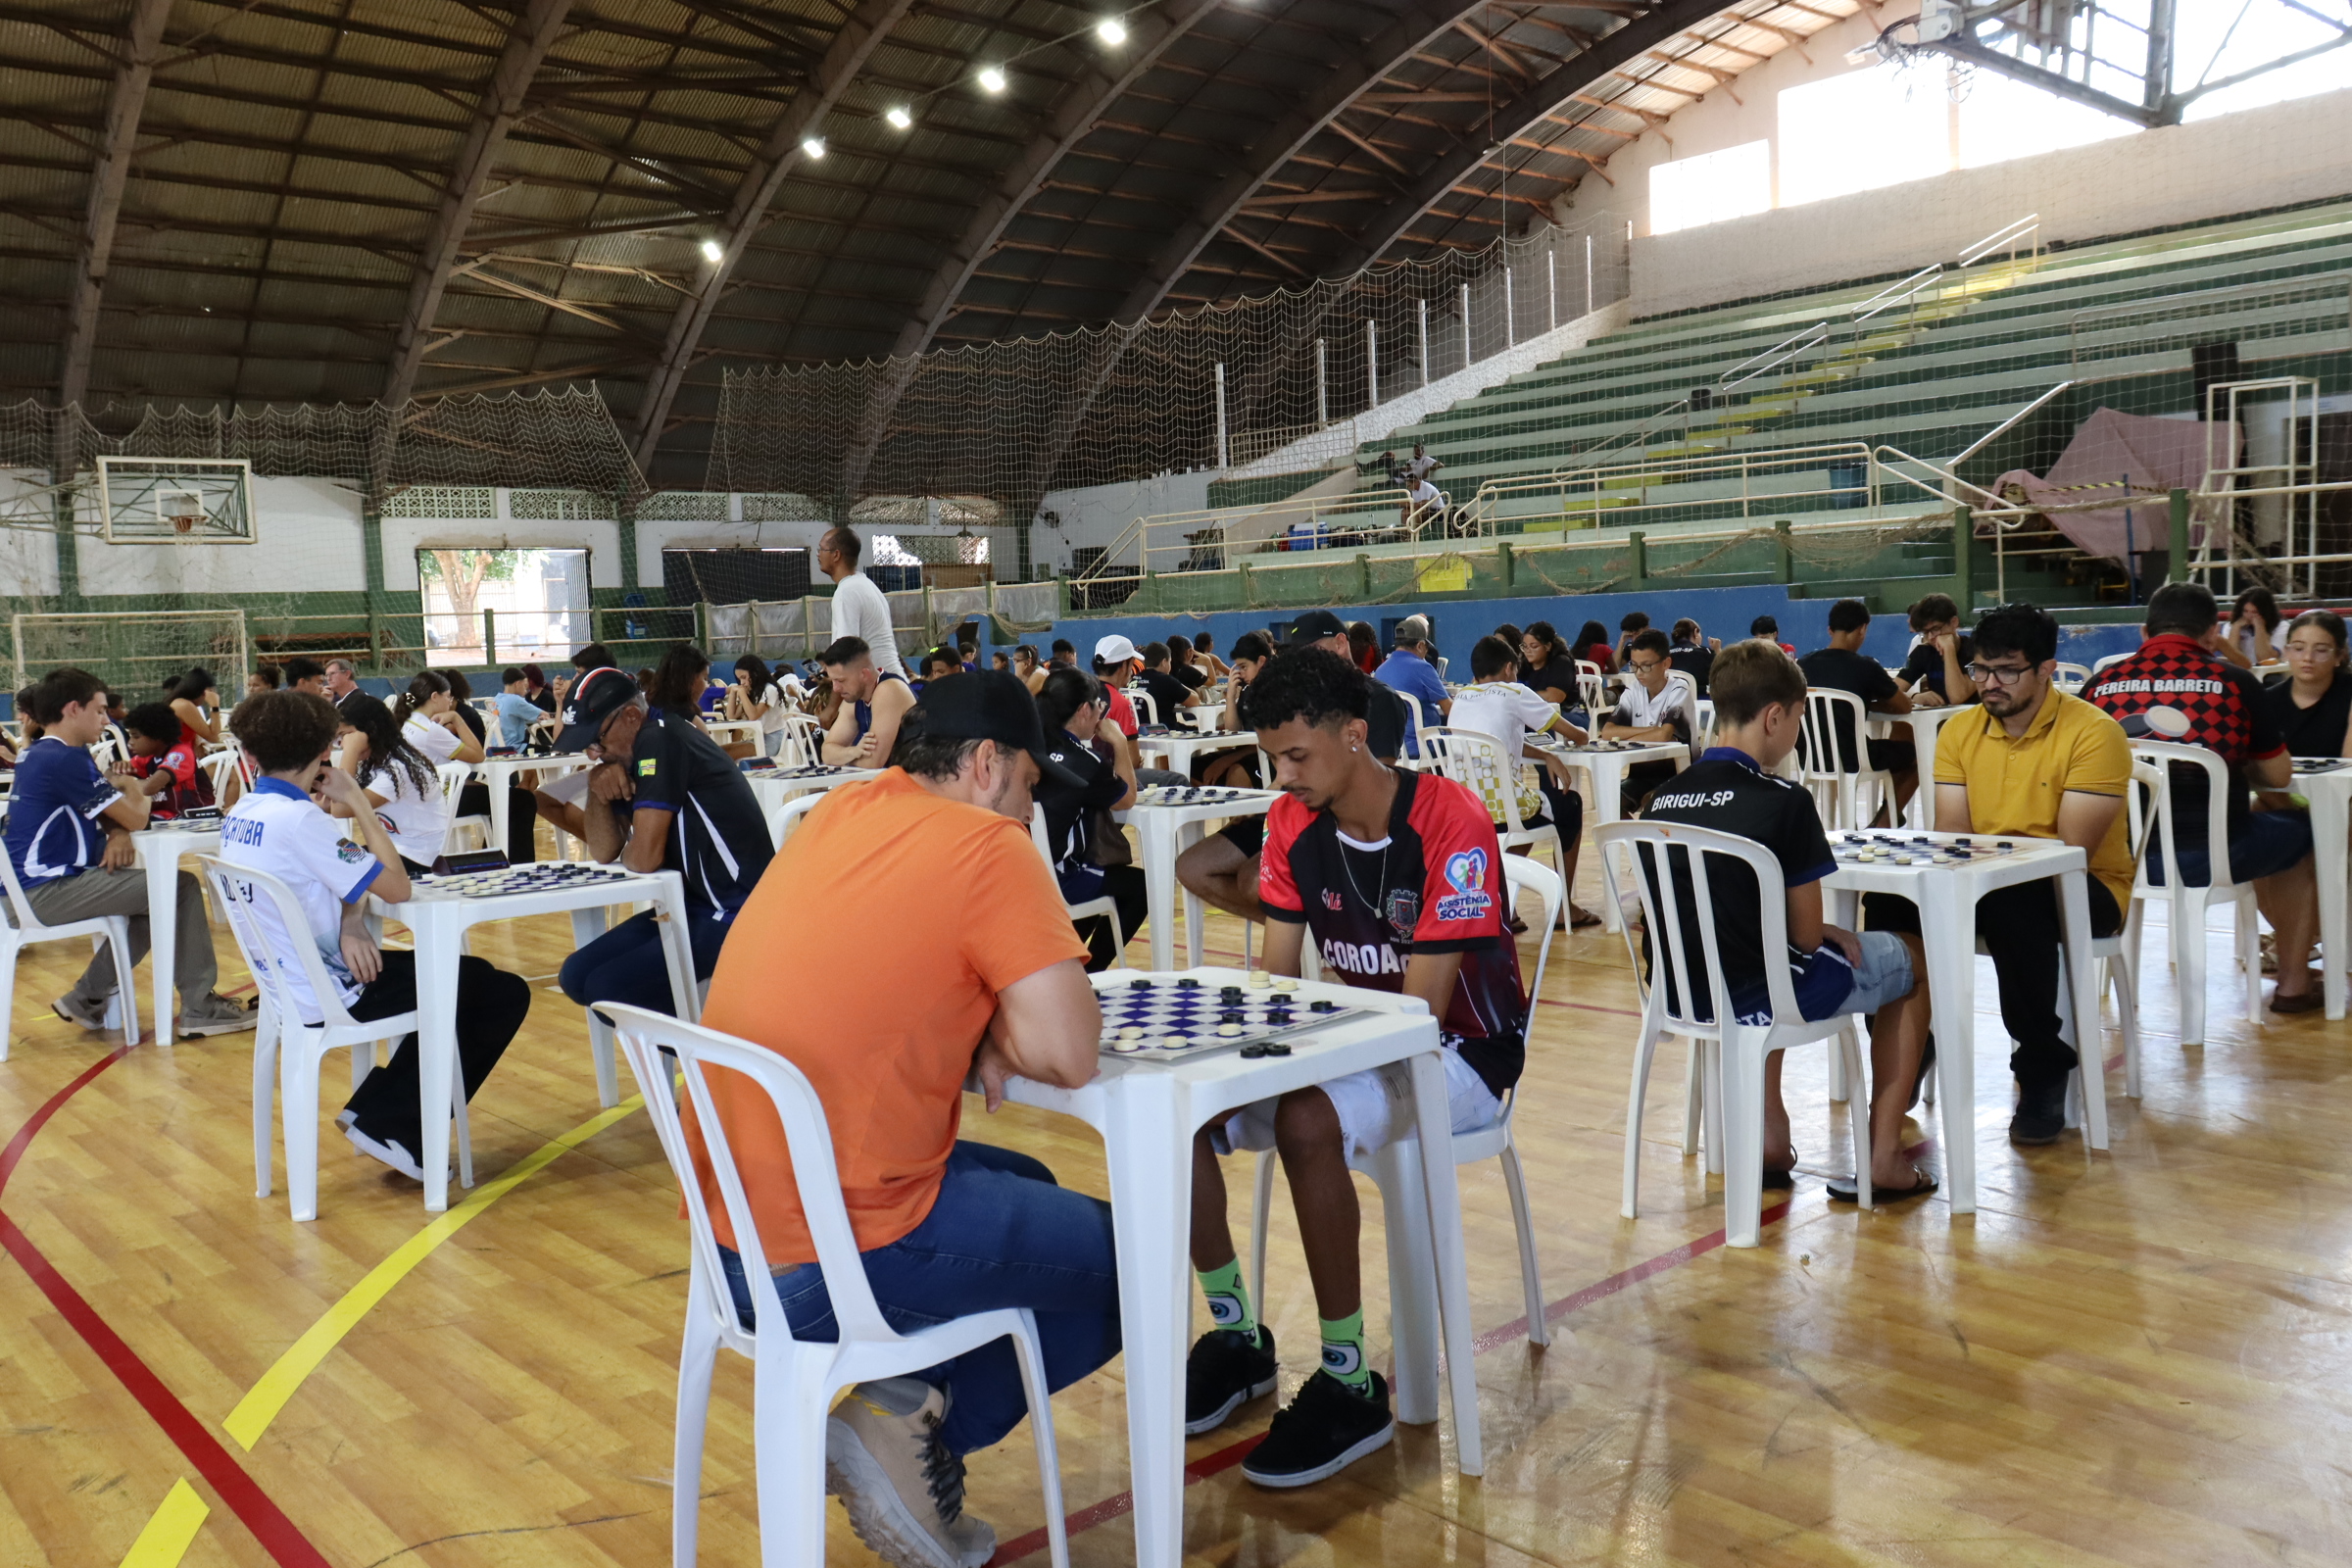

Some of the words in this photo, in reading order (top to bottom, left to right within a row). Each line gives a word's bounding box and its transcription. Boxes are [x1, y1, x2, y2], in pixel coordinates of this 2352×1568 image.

[1470, 689, 1506, 699] PLISTA
[2094, 679, 2150, 698] PEREIRA
[2153, 678, 2223, 695] BARRETO
[1651, 791, 1734, 812] BIRIGUI-SP
[1440, 906, 1483, 919] SOCIAL
